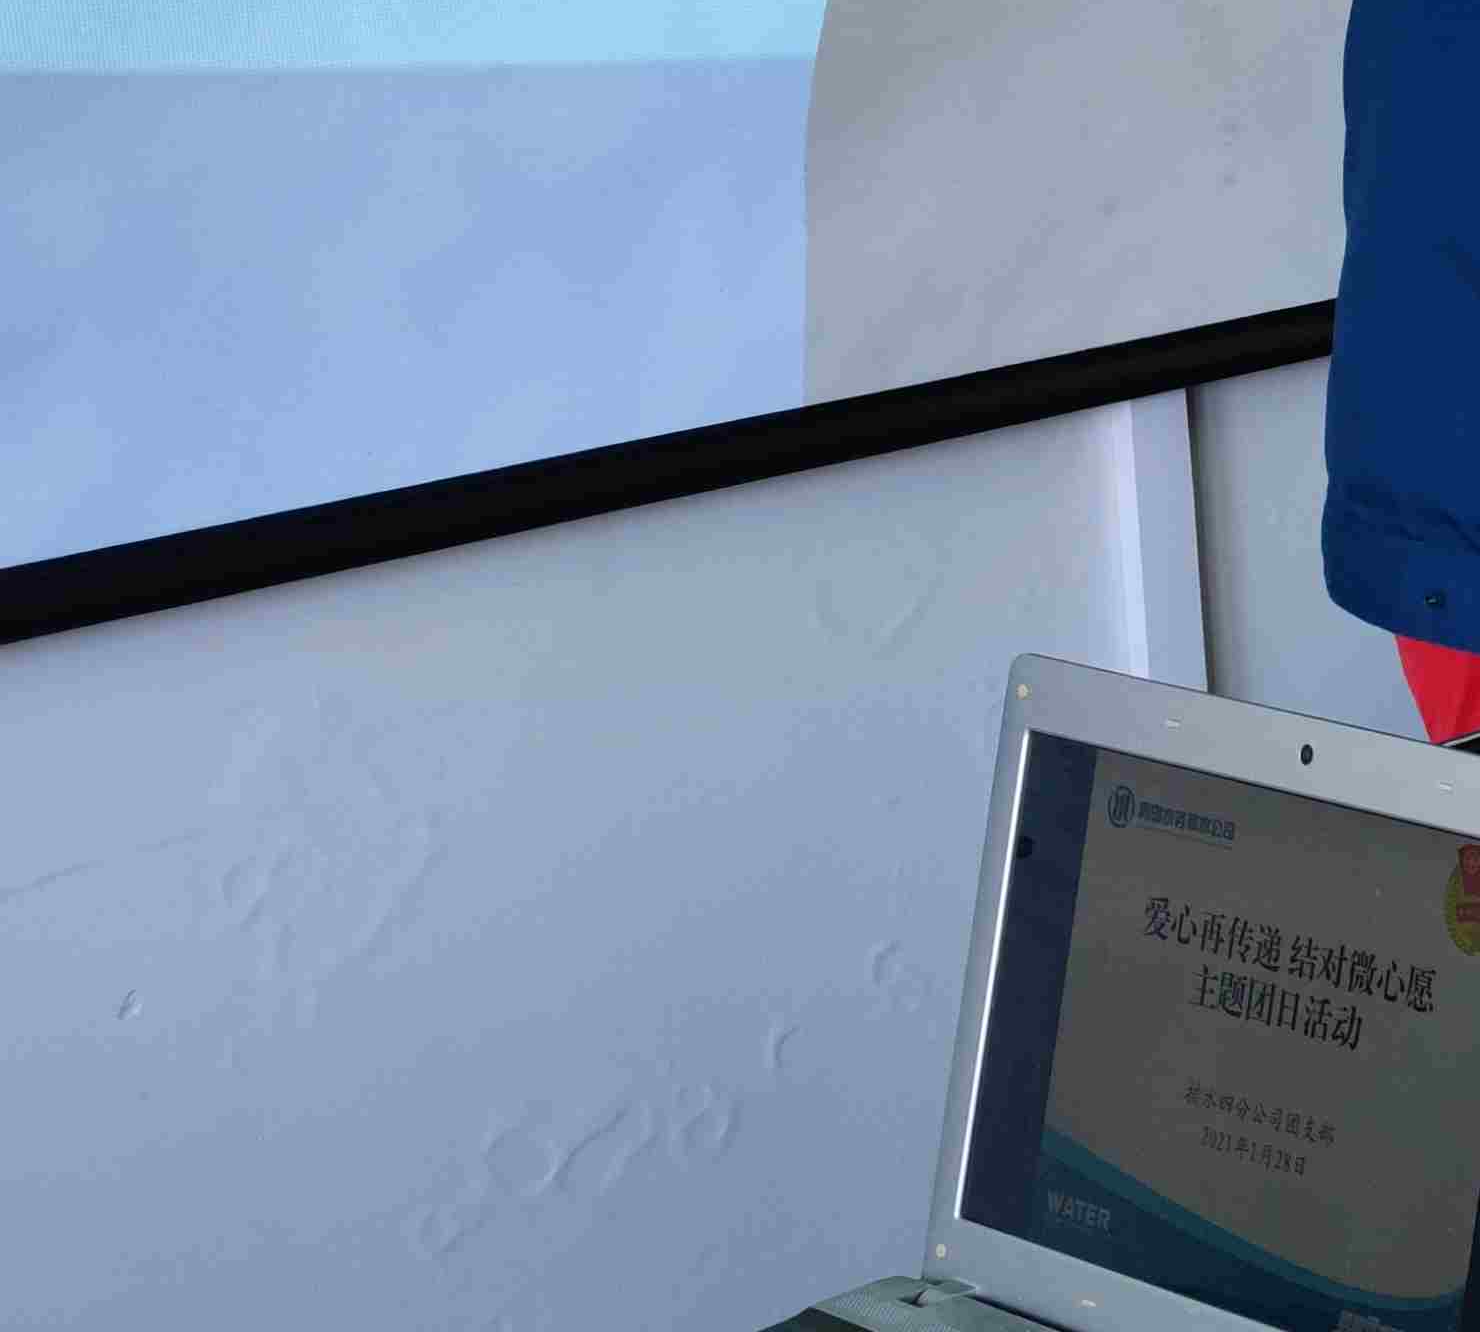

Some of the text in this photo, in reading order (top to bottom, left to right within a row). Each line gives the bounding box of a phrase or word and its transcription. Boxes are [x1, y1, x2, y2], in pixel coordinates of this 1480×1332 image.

[1143, 896, 1437, 1014] 爱心再传递 结对微心愿
[1188, 964, 1363, 1051] 主题团日活动
